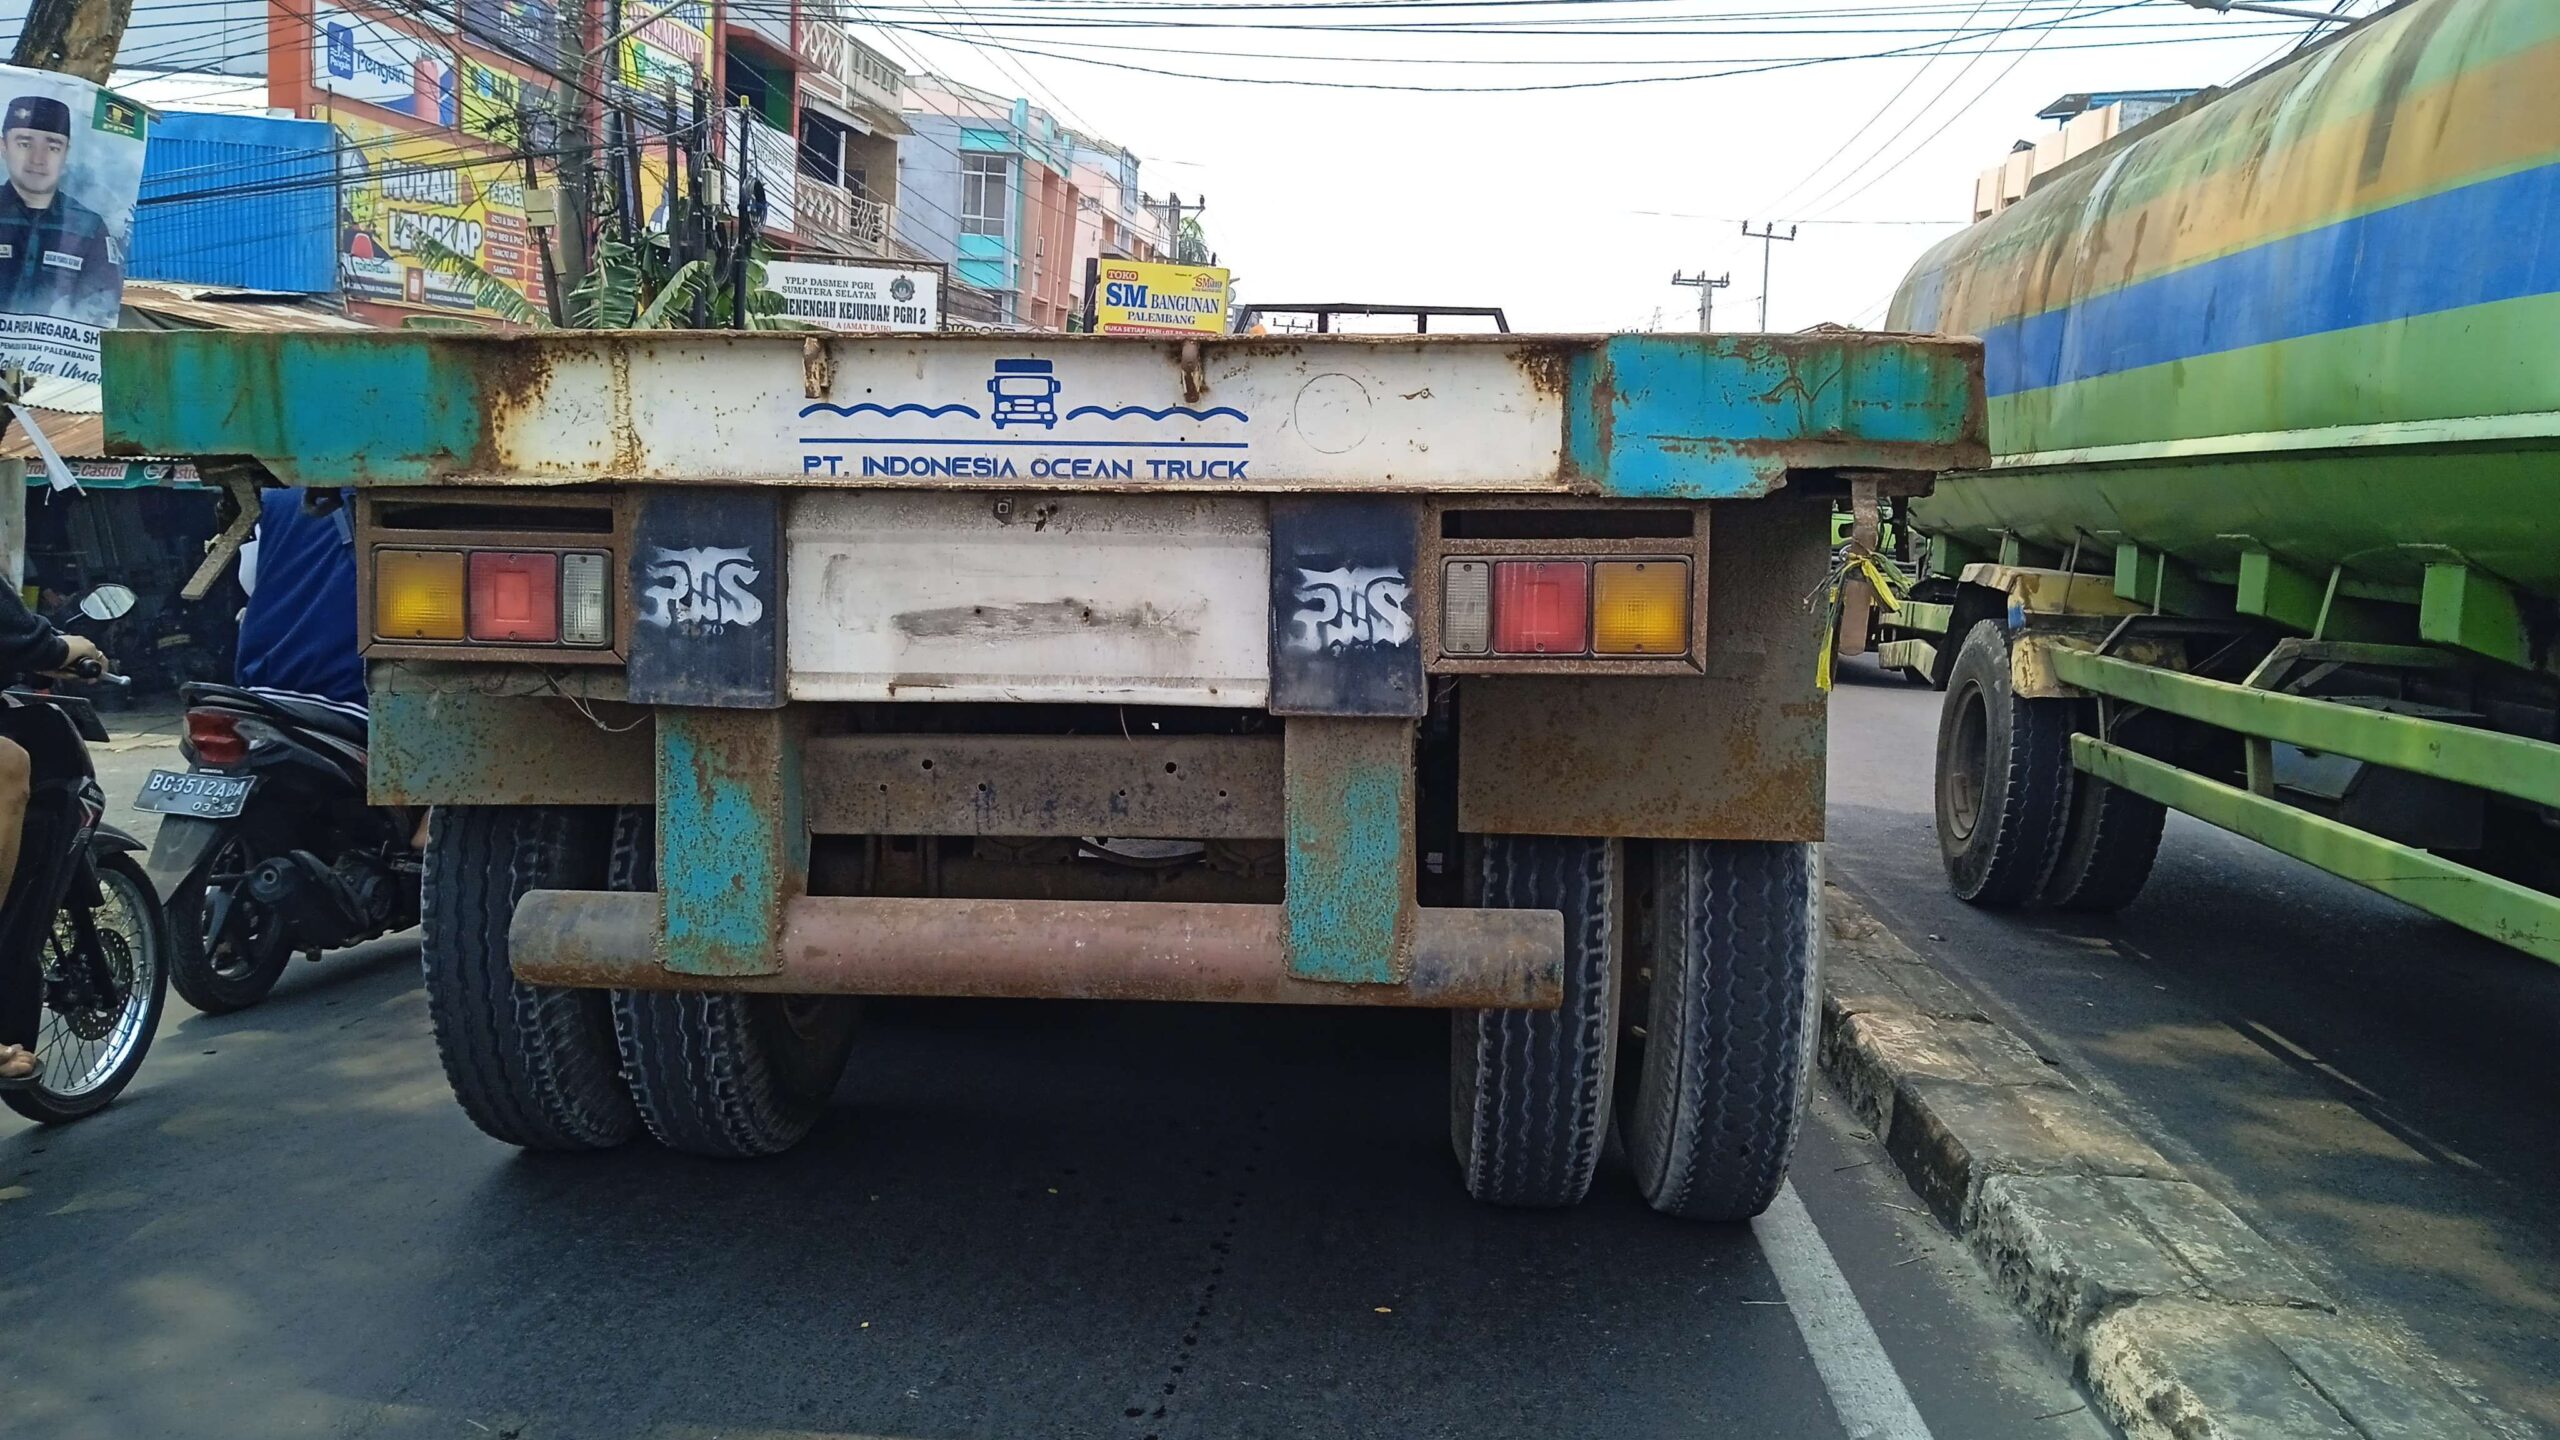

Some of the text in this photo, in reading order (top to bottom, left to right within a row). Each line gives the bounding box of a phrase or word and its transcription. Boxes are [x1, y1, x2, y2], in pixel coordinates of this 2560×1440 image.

[330, 56, 351, 72] Penguin
[357, 50, 405, 85] Penguin
[381, 158, 457, 206] MURAH
[388, 208, 483, 259] LENGKAP
[784, 276, 874, 290] YPLP DASMEN PGRI
[1108, 270, 1137, 280] TOKO
[781, 285, 877, 299] SUMATERA SELATAN
[1106, 282, 1220, 314] SM BANGUNAN
[839, 302, 890, 322] KEJURUAN
[893, 305, 917, 324] PGRI
[919, 307, 926, 325] 2
[1127, 311, 1196, 325] PALEMBANG
[33, 322, 81, 341] NEGARA.
[44, 345, 95, 362] PALEMBANG
[28, 355, 55, 374] dan
[80, 464, 124, 477] Castrol
[803, 455, 1250, 481] PT. INDONESIA OCEAN TRUCK
